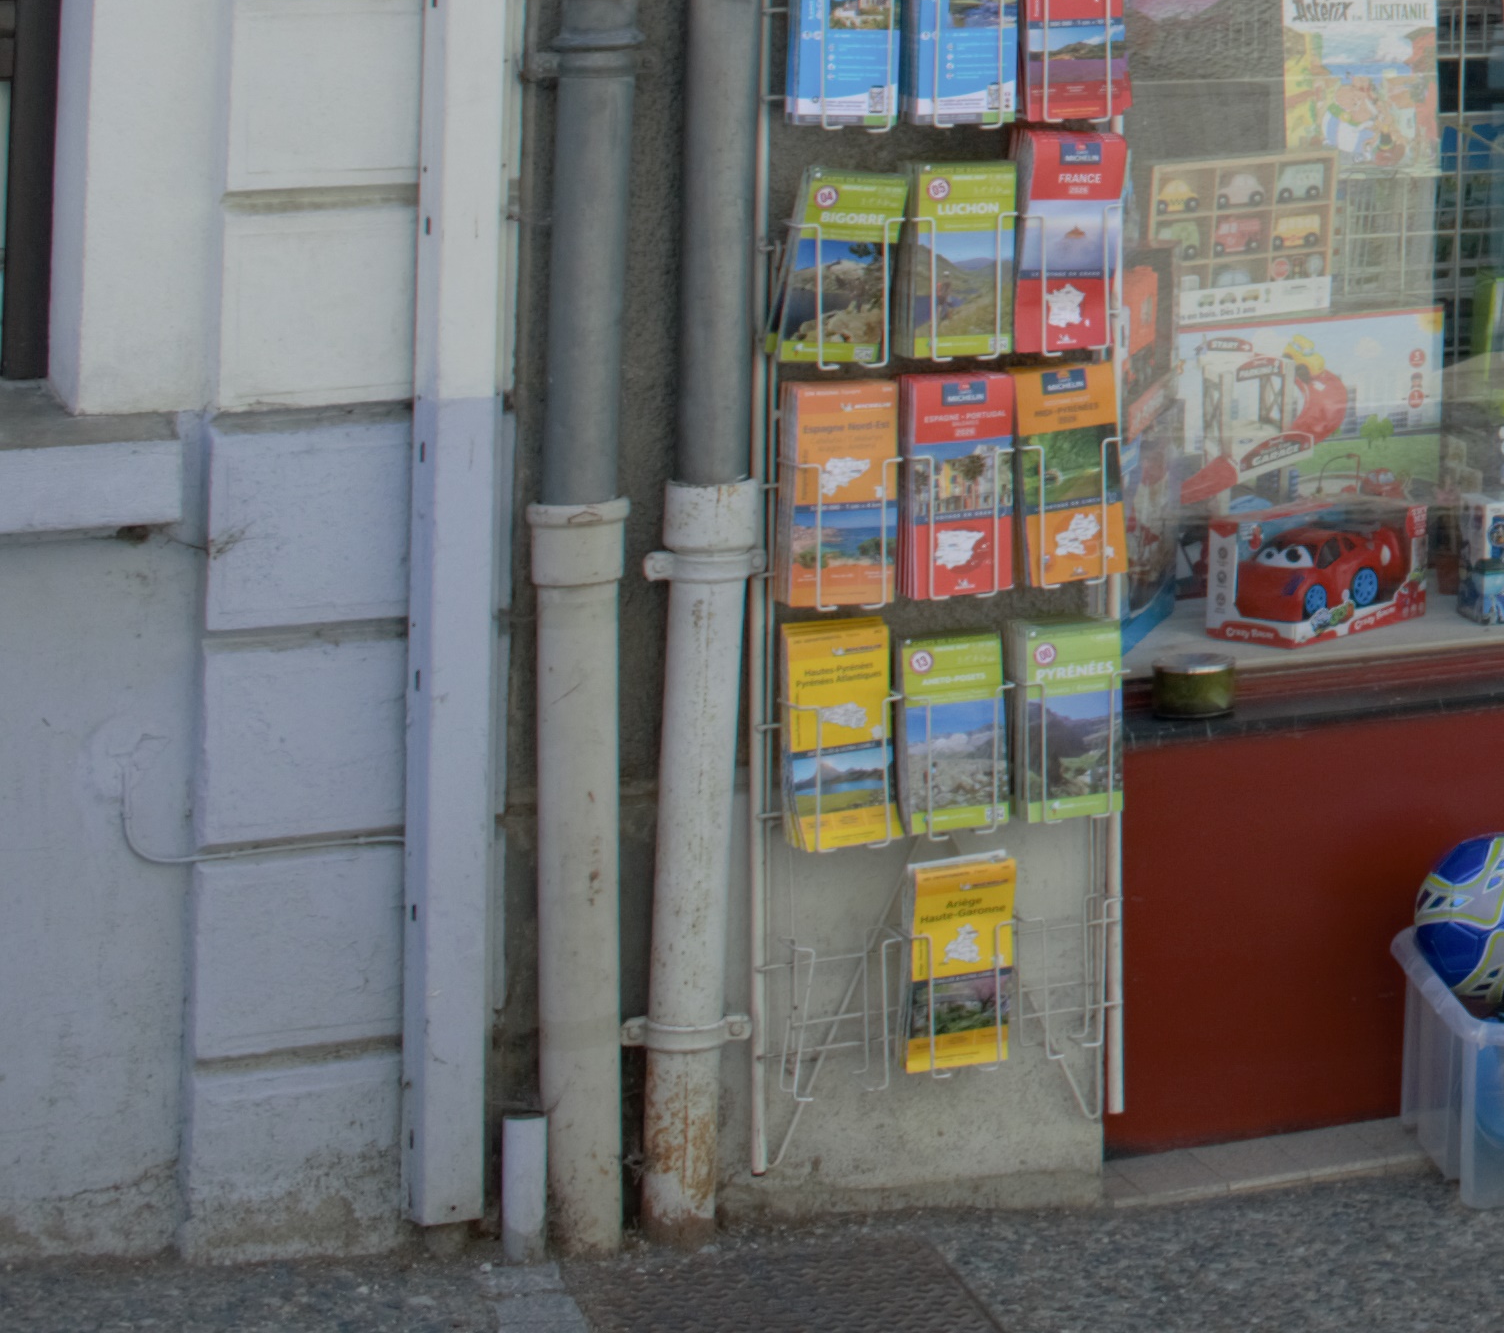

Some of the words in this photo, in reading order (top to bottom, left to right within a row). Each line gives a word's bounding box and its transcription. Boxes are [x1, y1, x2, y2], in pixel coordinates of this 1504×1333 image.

[1291, 0, 1354, 22] Astérix
[1064, 155, 1099, 163] MICHELIN
[1058, 173, 1102, 184] FRANCE
[937, 202, 999, 215] LUCHON
[820, 211, 886, 225] BIGORRE
[1211, 340, 1239, 350] START
[1046, 380, 1084, 392] MICHELIN
[947, 393, 984, 403] MICHELIN
[924, 414, 959, 423] ESPAGNE
[965, 410, 1006, 420] PORTUGAL
[803, 424, 844, 435] Espagne
[847, 421, 890, 431] Nord-Est
[1252, 442, 1302, 465] GARAGE
[804, 662, 874, 676] Hautes-Pyrénées
[1035, 660, 1115, 682] PYRÉNÉES
[796, 675, 834, 688] Pyrénées
[835, 671, 882, 684] Atlantiques
[945, 896, 983, 910] Ariège
[920, 903, 1007, 924] Haute-Garonne
